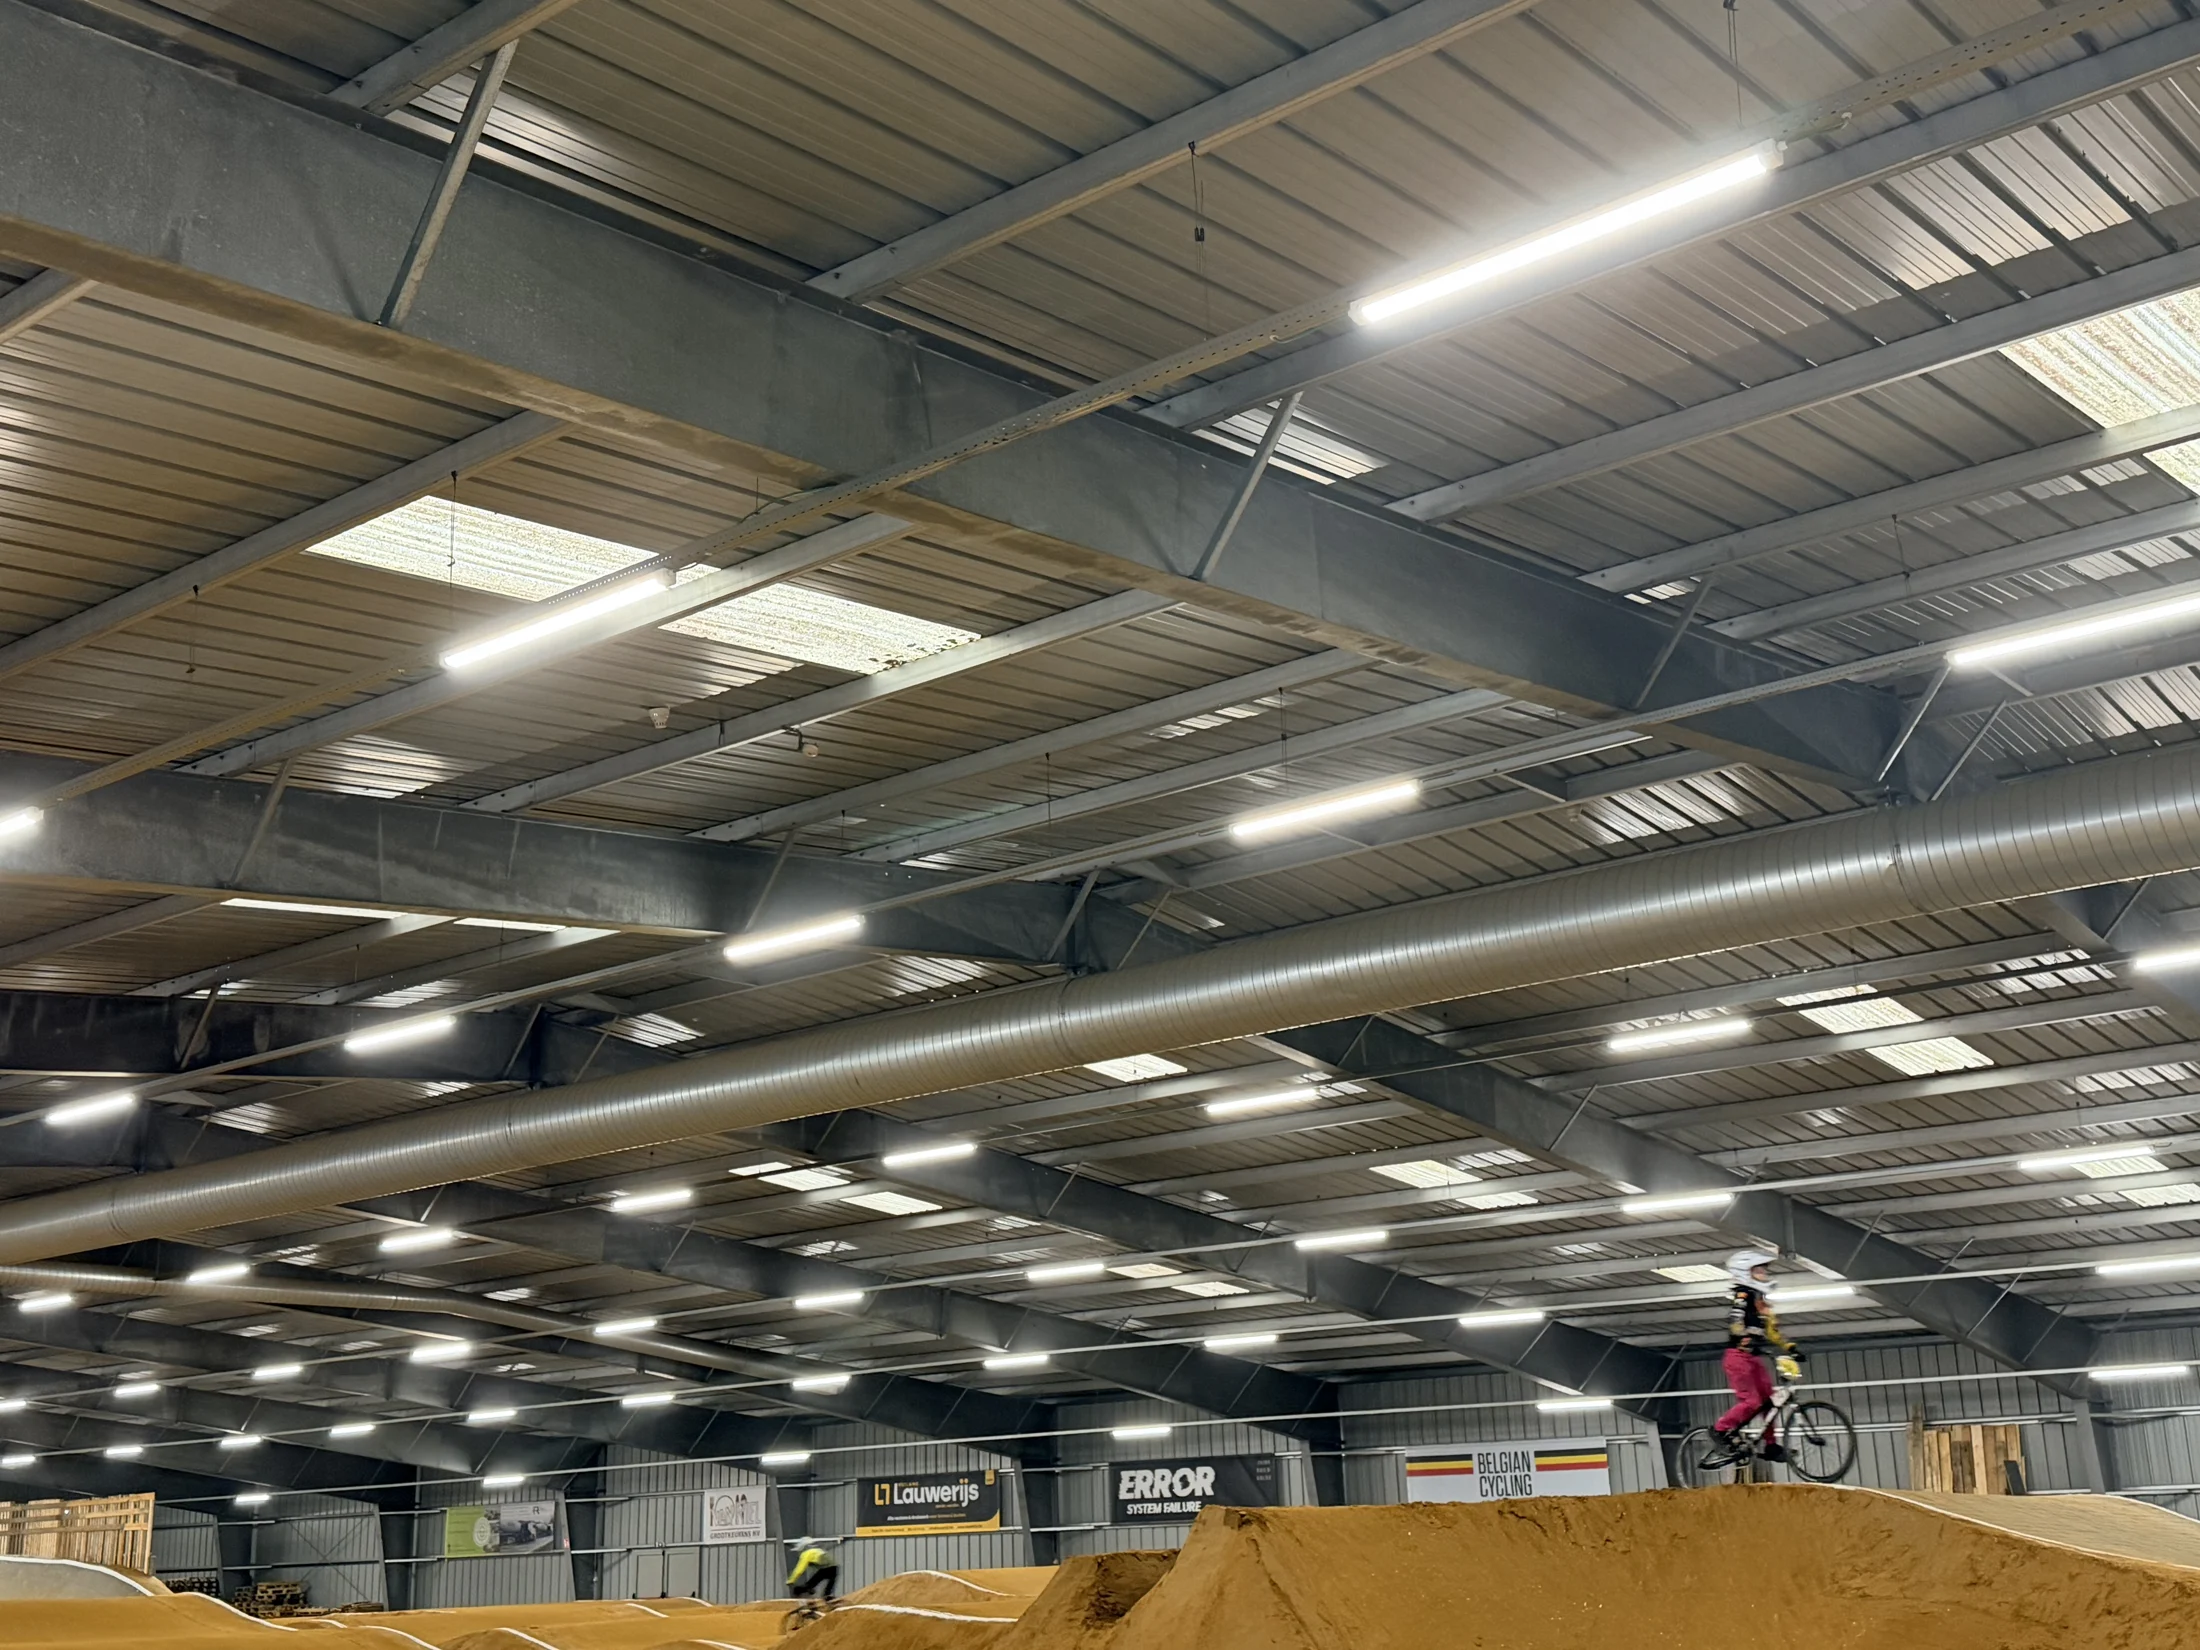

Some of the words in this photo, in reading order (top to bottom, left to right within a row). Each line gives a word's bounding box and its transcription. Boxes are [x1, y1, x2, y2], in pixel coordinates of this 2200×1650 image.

[1477, 1451, 1531, 1474] BELGIAN
[893, 1478, 980, 1508] Lauwerijs
[1118, 1466, 1216, 1500] ERROR
[1479, 1474, 1532, 1497] CYCLING
[1126, 1502, 1162, 1515] SYSTEM
[1163, 1501, 1202, 1513] FAILURE
